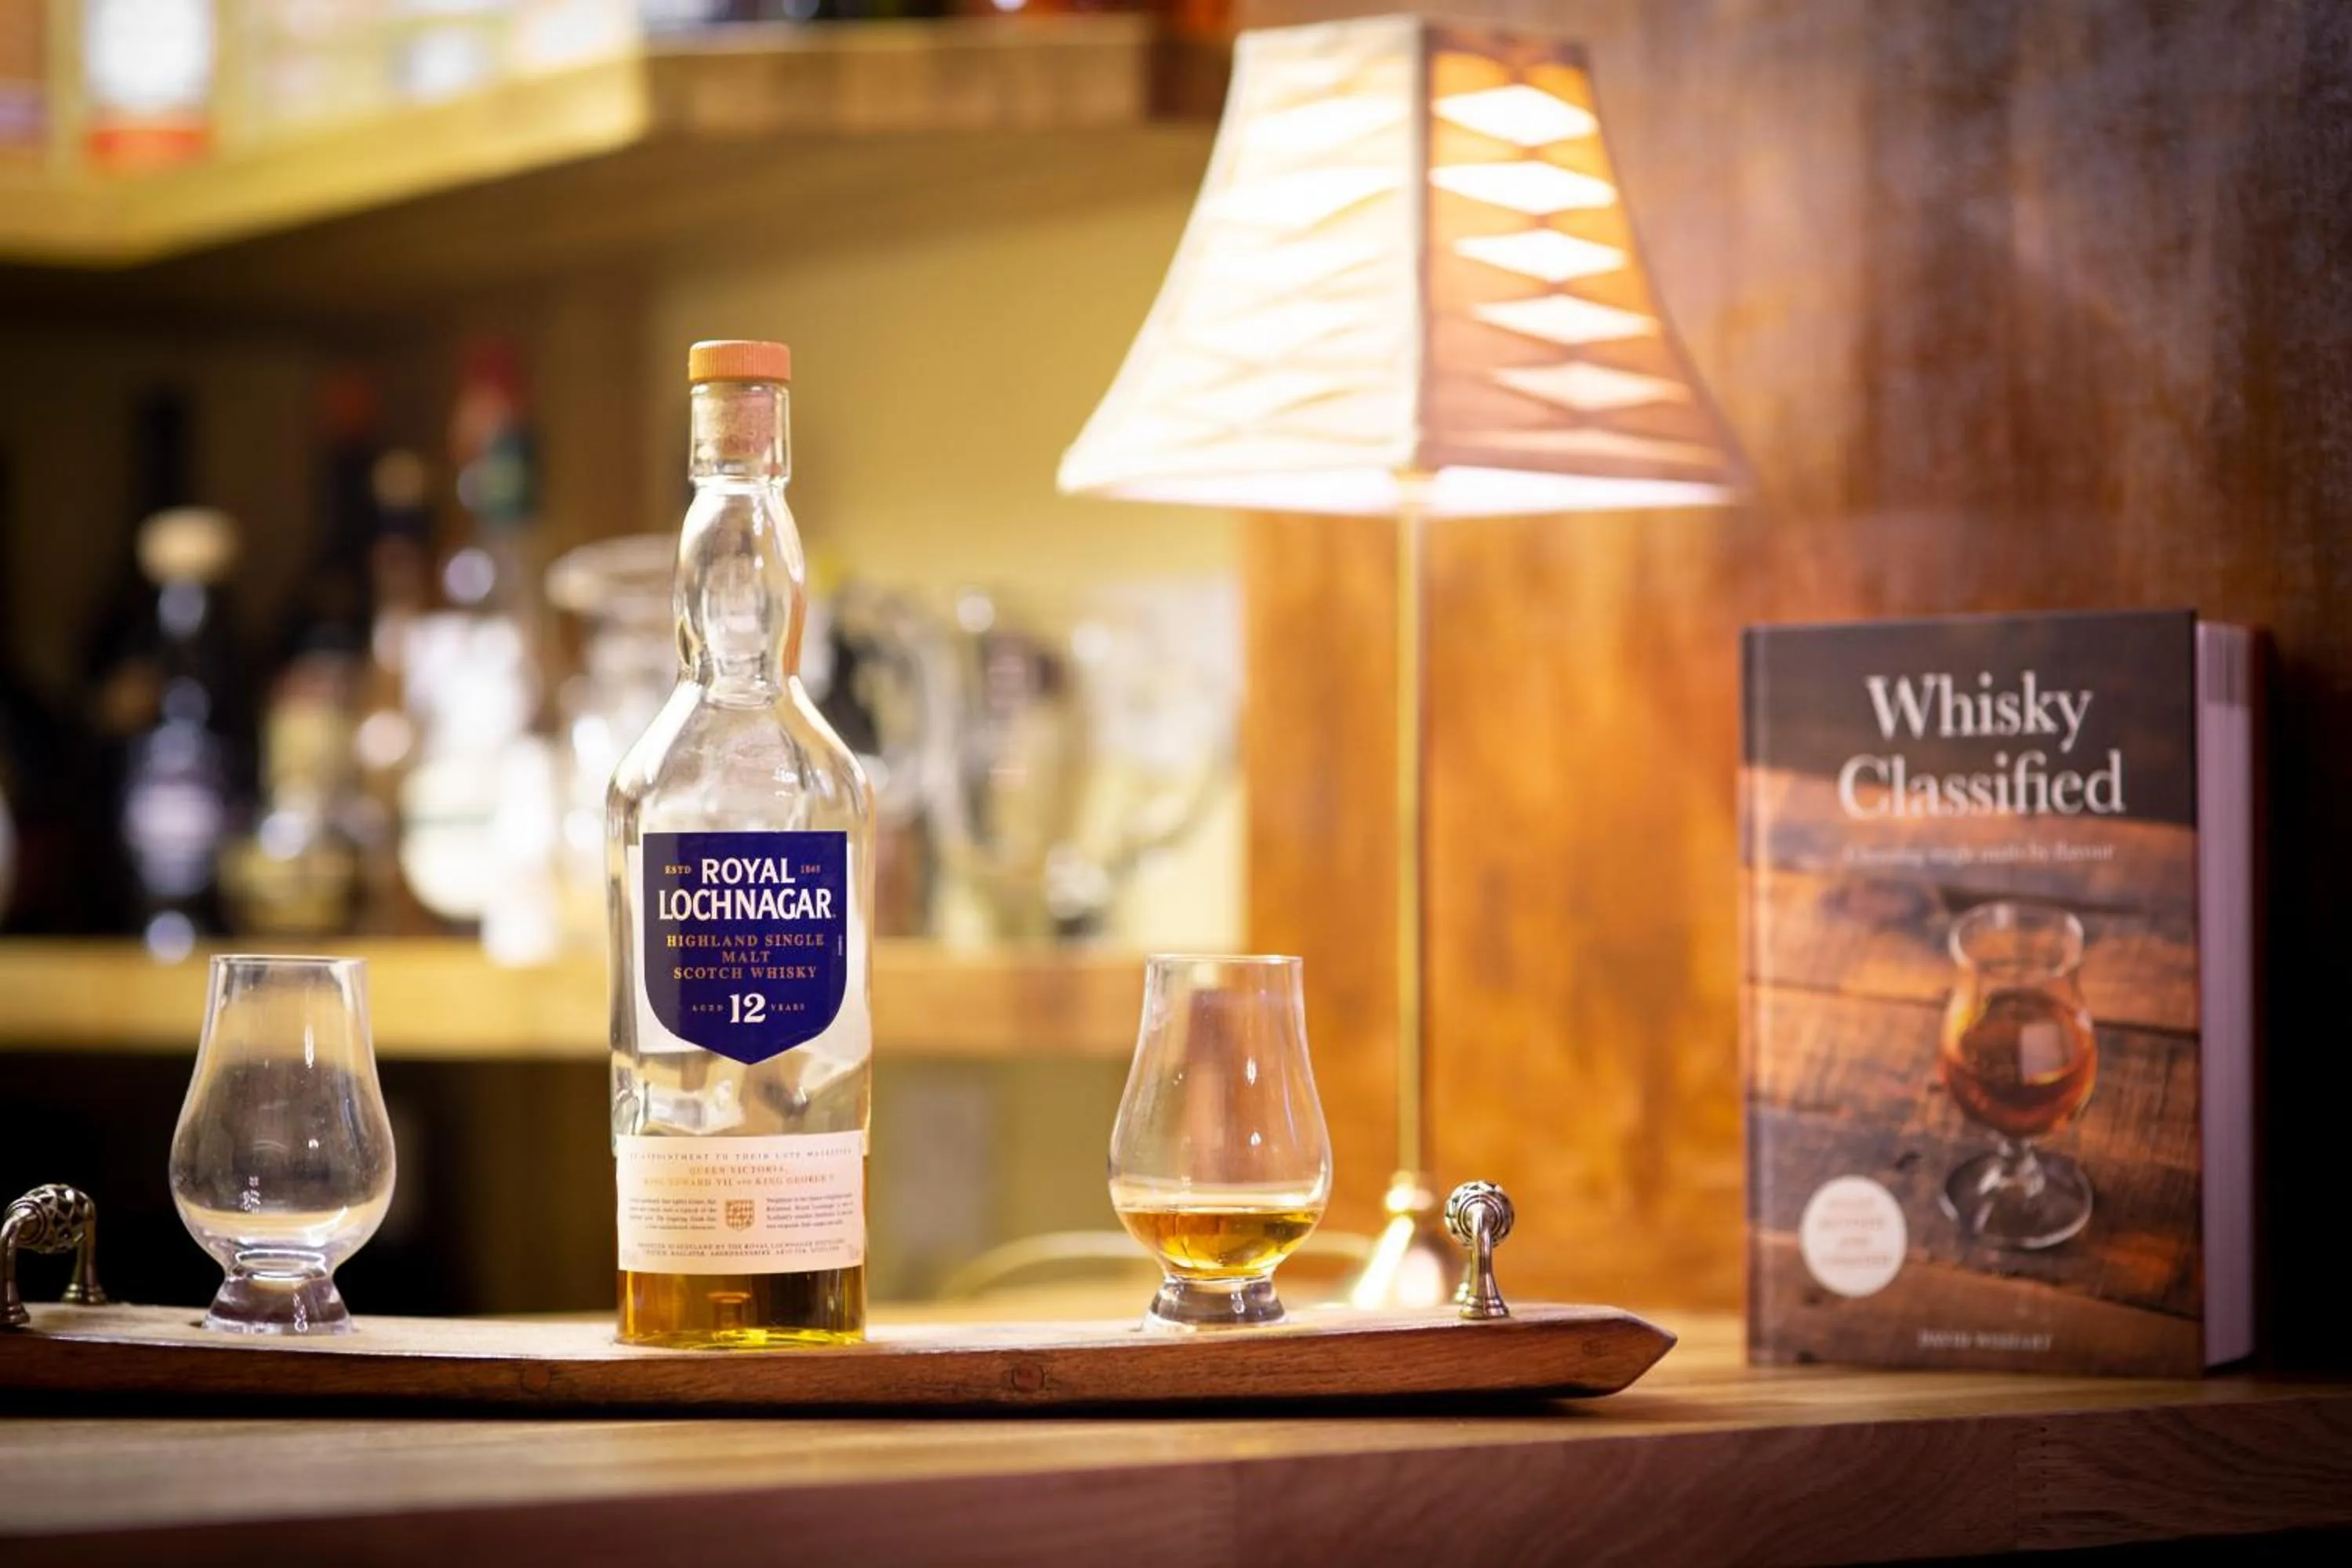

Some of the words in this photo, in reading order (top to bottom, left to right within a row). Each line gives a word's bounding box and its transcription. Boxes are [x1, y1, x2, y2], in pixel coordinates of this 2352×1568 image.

[1864, 670, 2093, 753] Whisky
[1838, 750, 2126, 820] Classified
[665, 865, 692, 875] ESTD
[702, 858, 796, 884] ROYAL
[659, 888, 833, 920] LOCHNAGAR
[666, 935, 758, 948] HIGHLAND
[765, 934, 824, 947] SINGLE
[722, 950, 771, 964] MALT
[673, 967, 742, 979] SCOTCH
[750, 965, 817, 978] WHISKY
[729, 993, 766, 1023] 12
[771, 1003, 804, 1011] YEARS
